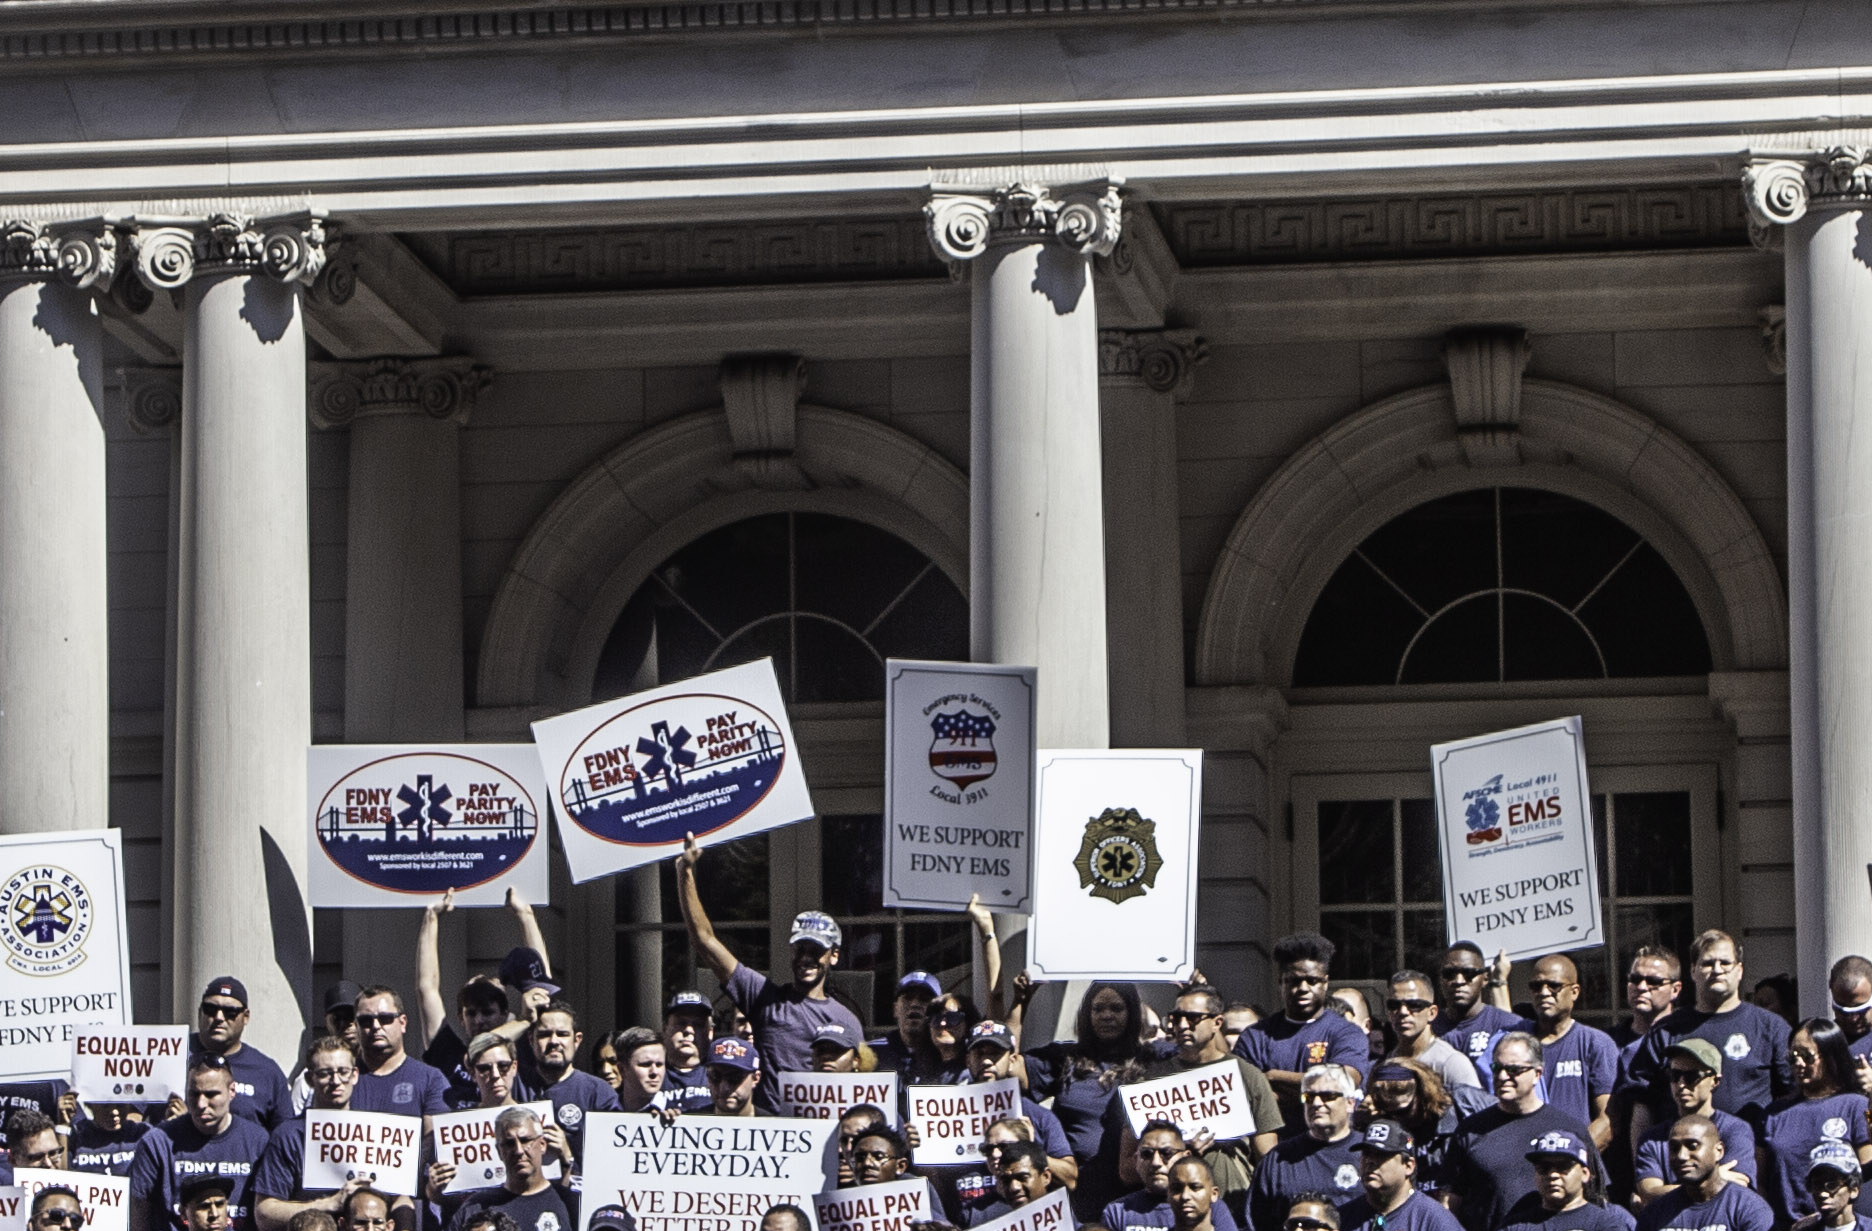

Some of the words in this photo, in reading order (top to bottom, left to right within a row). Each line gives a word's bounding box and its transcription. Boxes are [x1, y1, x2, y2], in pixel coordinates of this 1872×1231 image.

[923, 693, 968, 716] Emergency
[970, 693, 1001, 720] Services
[706, 711, 737, 731] PAY
[697, 721, 757, 748] PARITY
[950, 730, 977, 747] 911
[584, 745, 631, 773] FDNY
[708, 738, 753, 761] NOW!
[588, 764, 637, 791] EMS
[1507, 781, 1533, 791] Local
[1536, 773, 1557, 785] 4911
[346, 788, 392, 806] FDNY
[469, 784, 500, 796] PAY
[929, 785, 961, 804] Local
[967, 788, 989, 805] 3911
[1507, 787, 1560, 804] UNITED
[346, 807, 391, 824] EMS
[456, 798, 516, 811] PARITY
[1508, 796, 1562, 826] EMS
[464, 812, 506, 825] NOW!
[1510, 819, 1563, 836] WORKERS
[898, 824, 930, 843] WE
[934, 827, 1024, 848] SUPPORT
[367, 852, 483, 862] www.emsworkisdifferent.com
[911, 854, 965, 873] FDNY
[970, 858, 1010, 876] EMS
[61, 874, 89, 910] EMS
[1459, 888, 1492, 909] WE
[1496, 868, 1584, 902] SUPPORT
[1475, 907, 1529, 933] FDNY
[1534, 899, 1574, 921] EMS
[1, 924, 87, 958] ASSOCIATION
[21, 993, 117, 1016] SUPPORT
[77, 1036, 144, 1056] EQUAL
[147, 1037, 182, 1056] PAY
[104, 1059, 154, 1077] NOW
[1556, 1062, 1582, 1078] EMS
[1130, 1084, 1194, 1111] EQUAL
[1200, 1073, 1234, 1095] PAY
[1190, 1098, 1231, 1120] EMS
[311, 1122, 376, 1144] EQUAL
[381, 1127, 415, 1149] PAY
[613, 1124, 724, 1149] SAVING
[732, 1128, 812, 1153] LIVES
[320, 1143, 357, 1164] FOR
[364, 1148, 403, 1168] EMS
[632, 1152, 790, 1178] EVERYDAY.
[617, 1189, 664, 1213] WE
[1033, 1201, 1065, 1230] PAY
